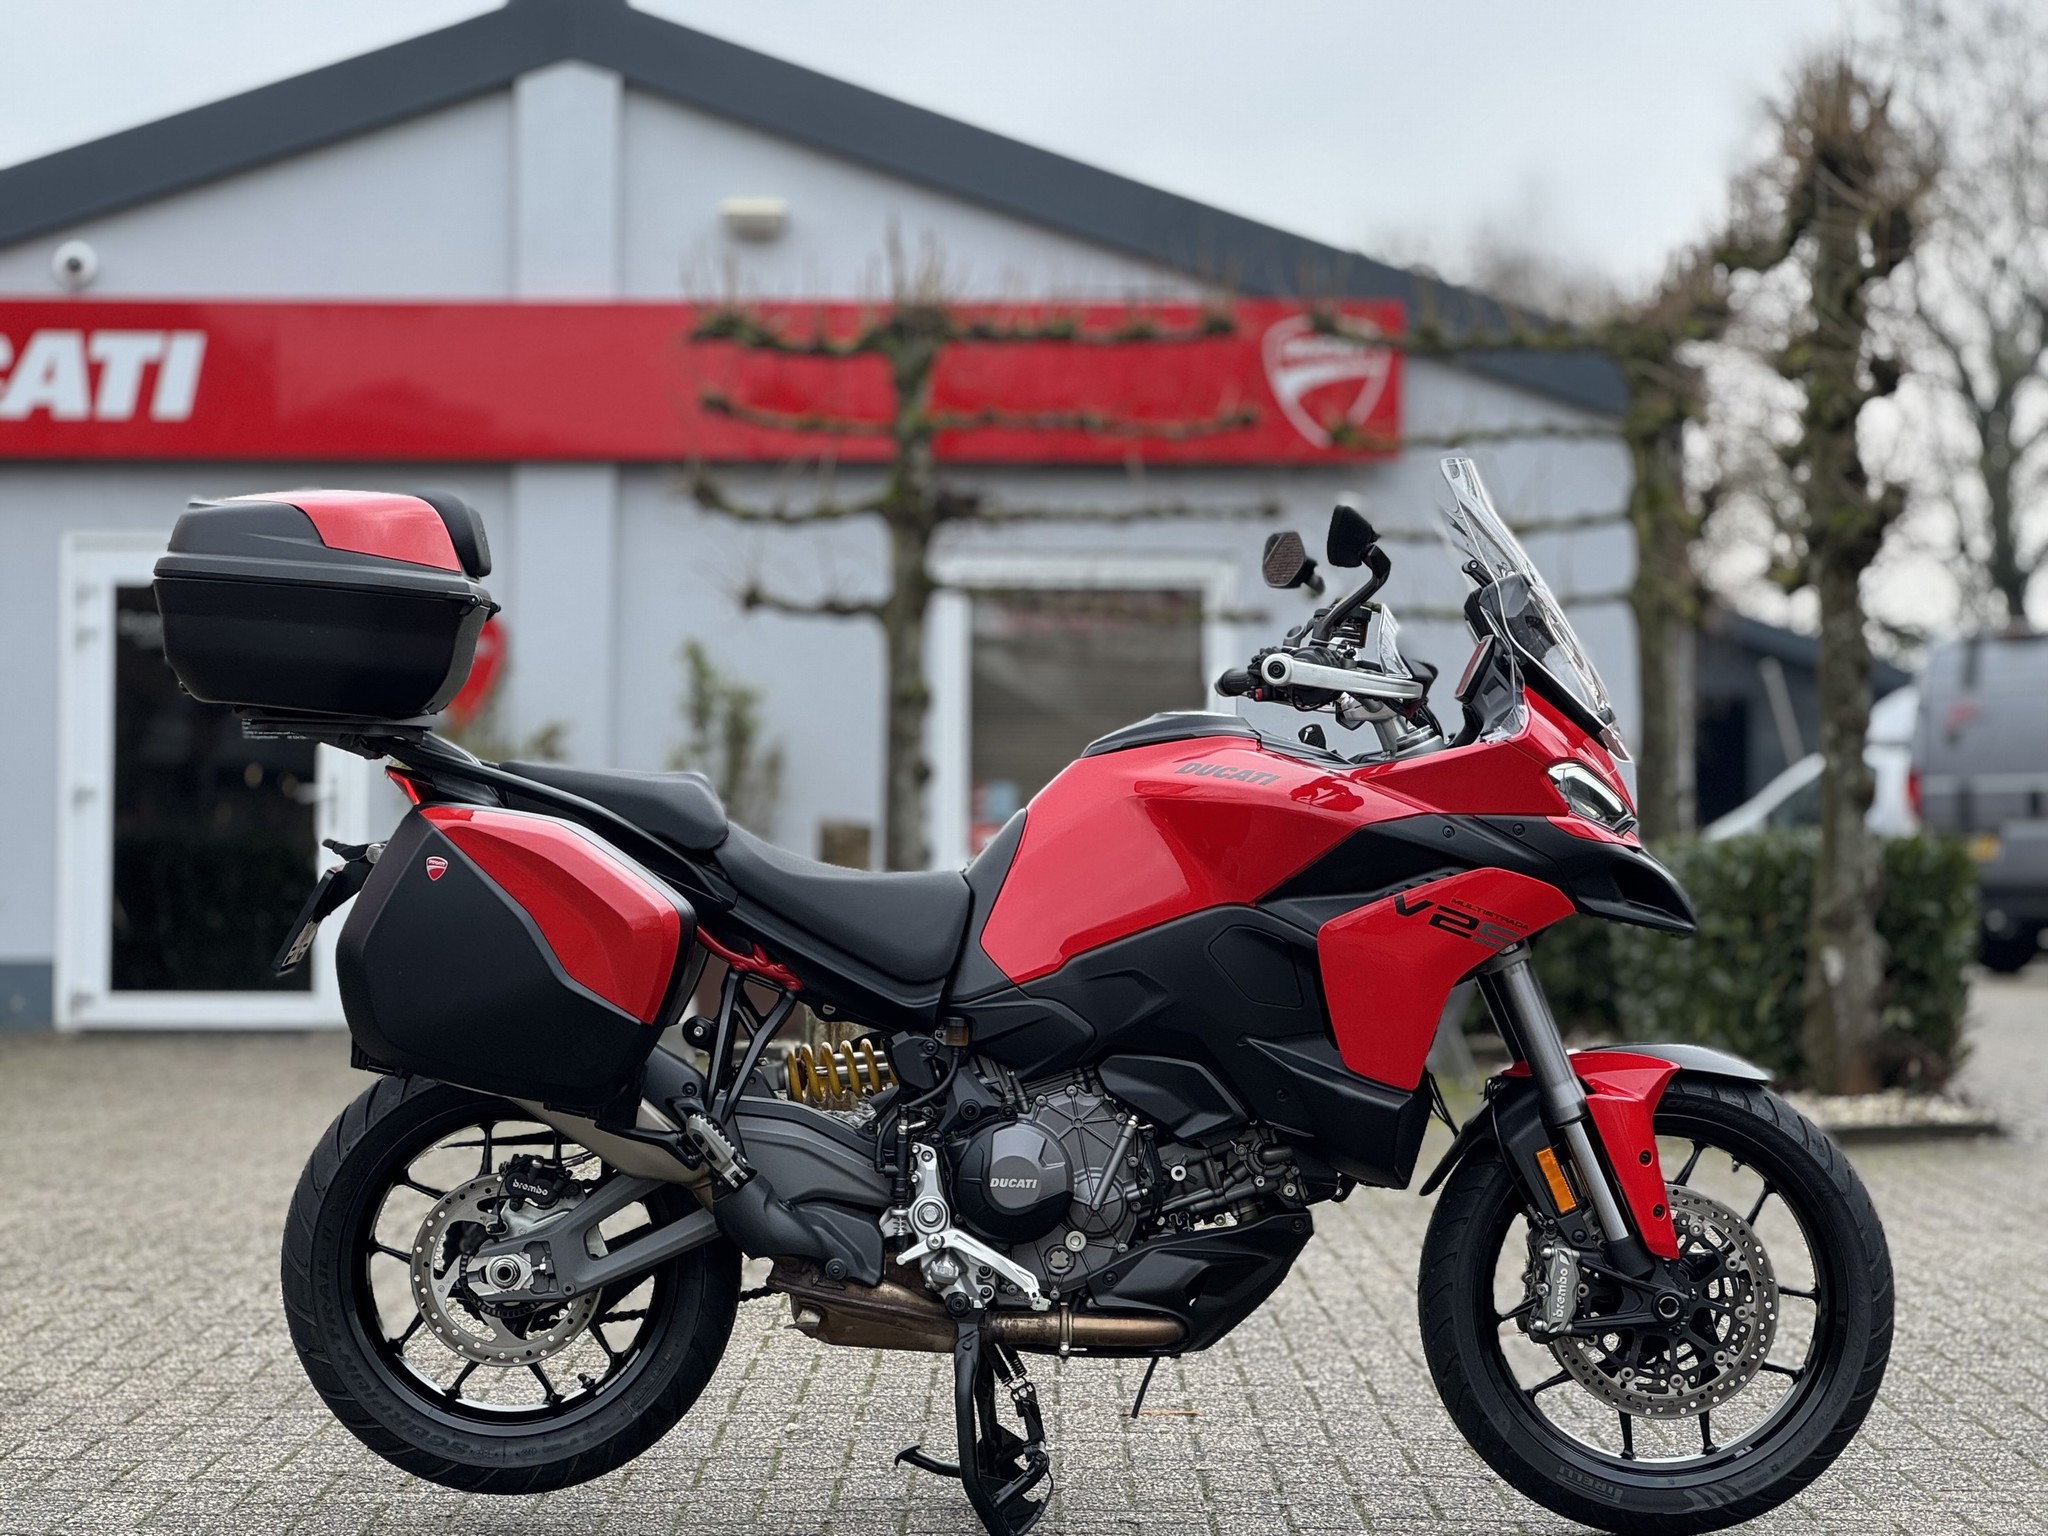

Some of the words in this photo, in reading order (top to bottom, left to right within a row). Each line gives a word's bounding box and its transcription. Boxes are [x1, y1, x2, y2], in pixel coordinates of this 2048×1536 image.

[0, 329, 208, 421] ATI
[1175, 762, 1281, 785] DUCATI
[1451, 898, 1529, 930] MULTISTRADA
[512, 1179, 548, 1196] brembo
[989, 1177, 1038, 1189] DUCATI
[1552, 1268, 1568, 1318] brembo
[1556, 1465, 1623, 1504] PIRELLI
